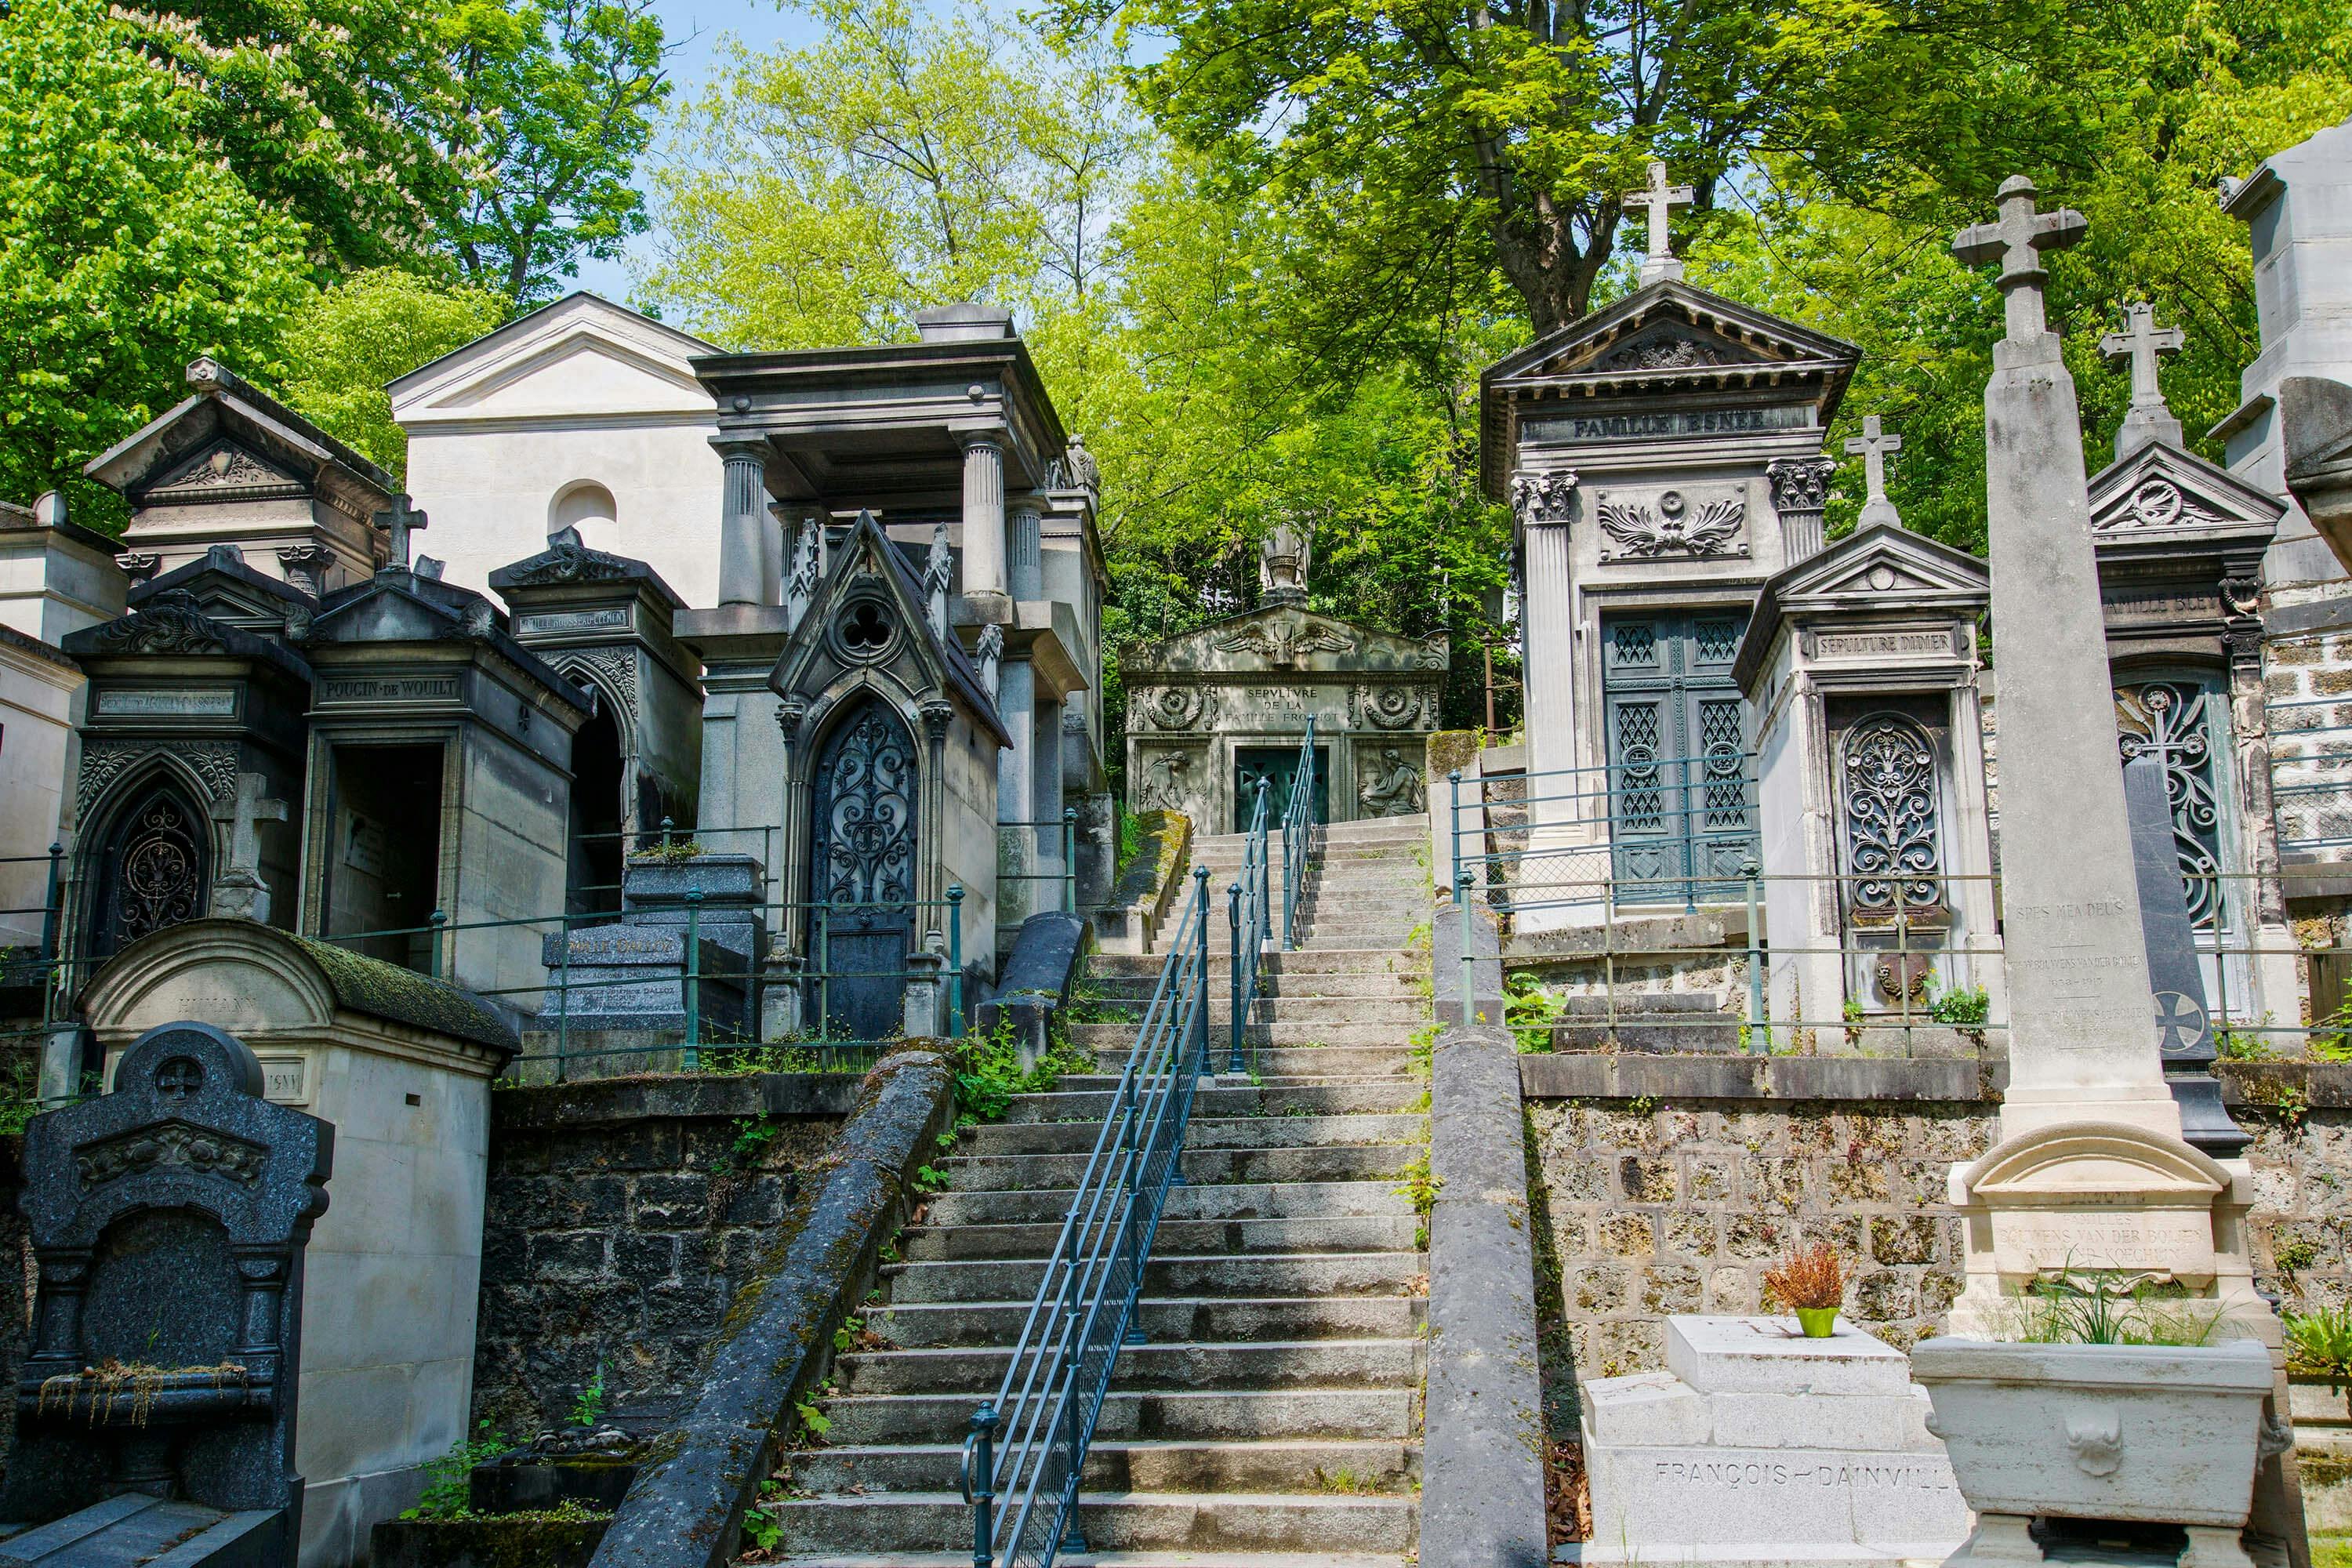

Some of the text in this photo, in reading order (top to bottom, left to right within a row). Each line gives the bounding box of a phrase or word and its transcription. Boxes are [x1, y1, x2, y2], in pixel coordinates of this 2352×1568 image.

[1574, 414, 1669, 437] FAMILLE
[2102, 593, 2167, 615] AMILLE
[1900, 633, 1950, 651] DIDIER
[1287, 701, 1302, 710] LA
[1225, 713, 1338, 722] FAMILLE FROHOT
[2016, 902, 2124, 920] SPES MEA DEUS
[2076, 1229, 2107, 1243] VAN
[2111, 1229, 2141, 1243] DER
